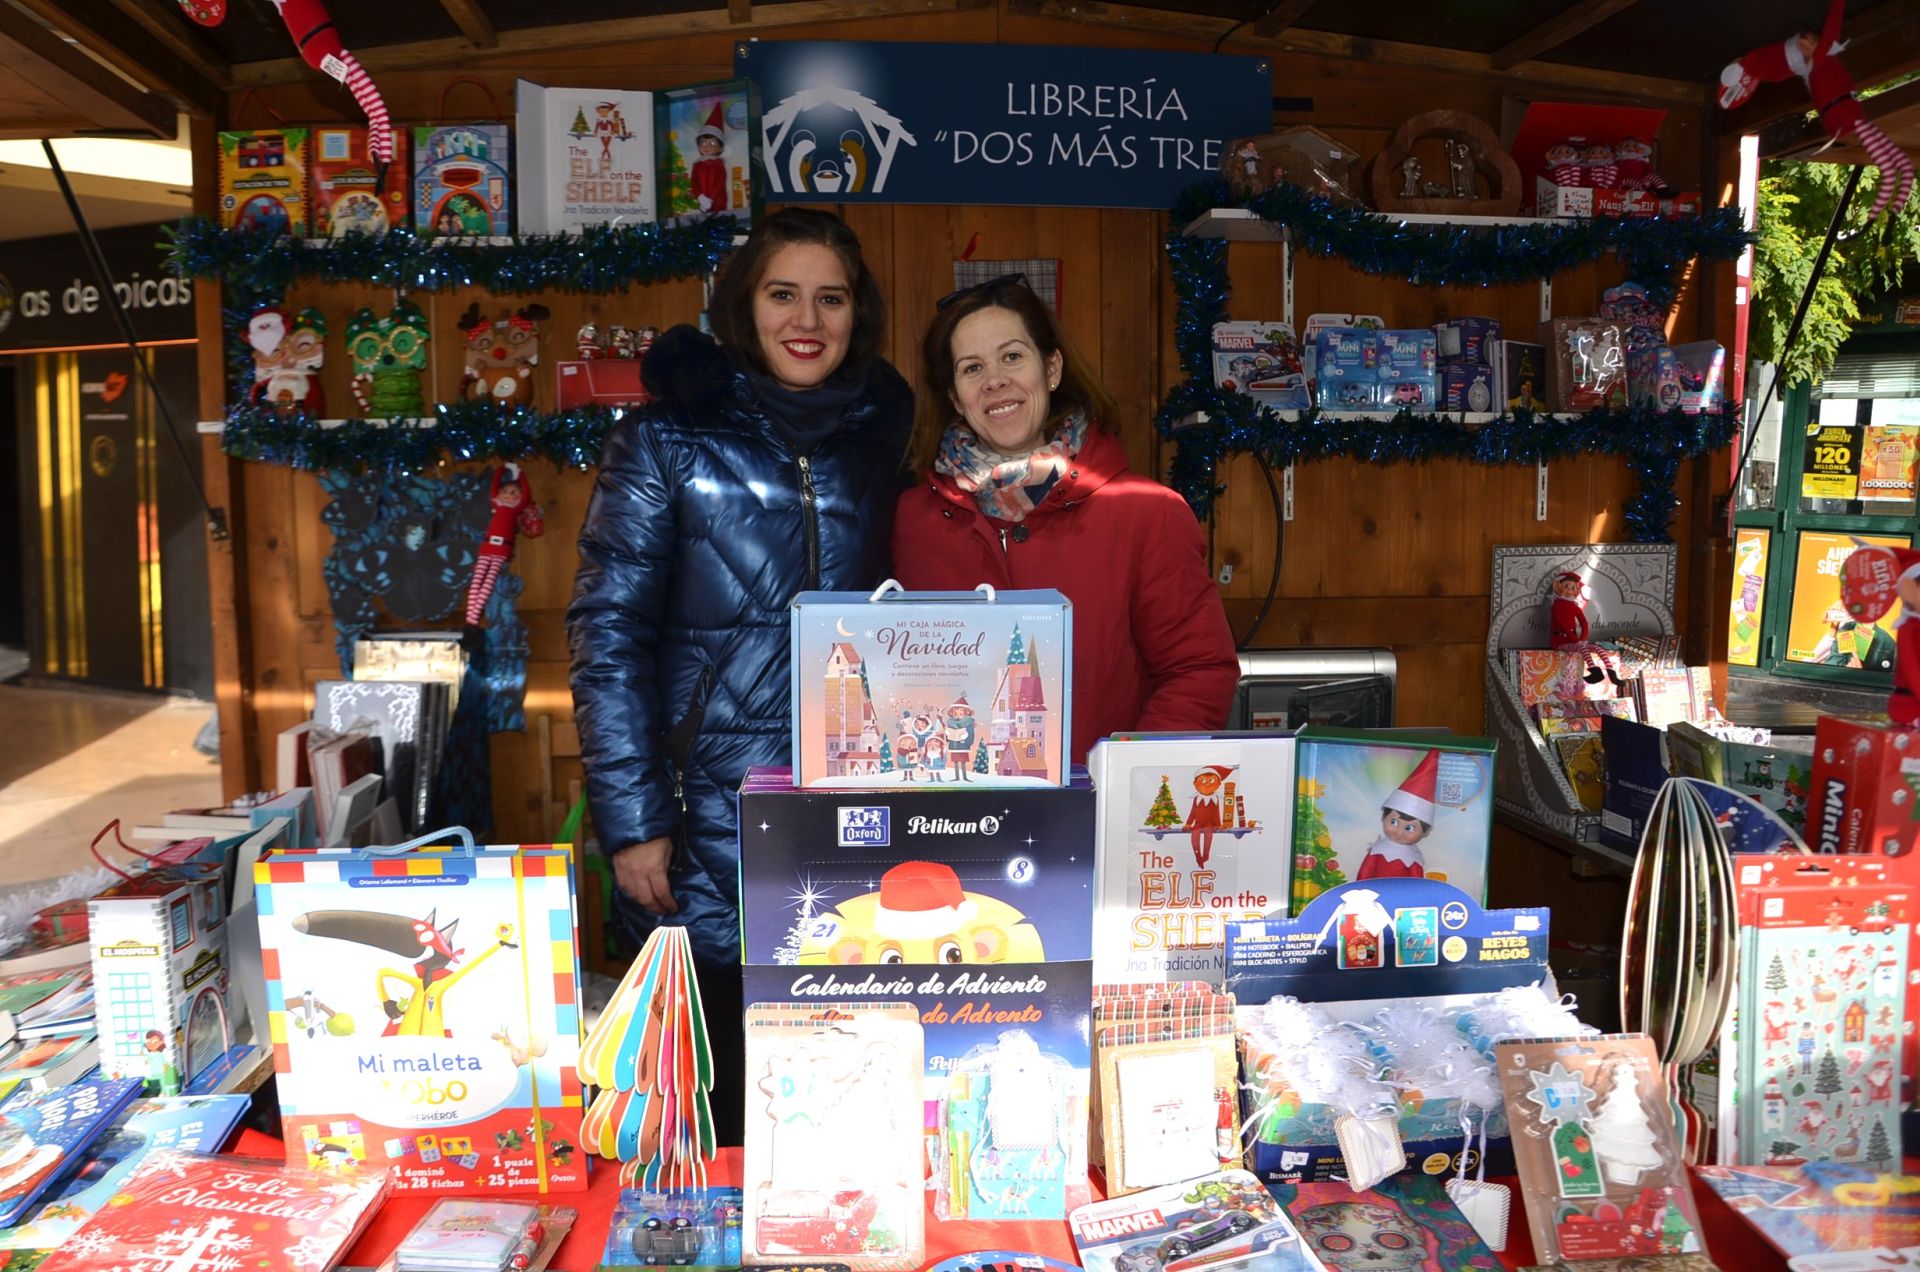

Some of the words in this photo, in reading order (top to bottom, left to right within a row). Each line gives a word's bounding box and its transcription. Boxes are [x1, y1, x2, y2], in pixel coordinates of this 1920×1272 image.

[1007, 78, 1188, 121] LIBRERÍA
[568, 146, 588, 156] The
[1047, 125, 1138, 170] MÁS
[570, 158, 611, 179] ELF
[609, 172, 623, 180] on
[625, 170, 642, 180] the
[566, 181, 642, 203] SHELF
[20, 290, 50, 318] as
[62, 278, 99, 314] de
[1219, 337, 1254, 349] MARVEL
[1814, 447, 1851, 464] 120
[910, 621, 930, 629] CAJA
[933, 619, 965, 628] MÁGICA
[877, 627, 986, 661] Navidad
[847, 827, 881, 841] Oxford
[907, 816, 977, 835] Pelikan
[1139, 851, 1174, 868] The
[1012, 860, 1030, 880] 8
[1140, 870, 1216, 910] ELF
[1211, 896, 1233, 909] on
[1238, 890, 1267, 907] the
[1445, 910, 1464, 921] 24x
[812, 923, 837, 937] 21
[1482, 935, 1528, 948] REYES
[115, 947, 157, 956] HOSPITAL
[1479, 947, 1530, 961] MAGOS
[1152, 955, 1210, 971] Tradición
[791, 972, 914, 996] Calendario
[917, 972, 945, 995] de
[947, 972, 1047, 996] Adviento
[921, 1002, 949, 1024] do
[950, 1002, 1043, 1024] Advento
[358, 1053, 385, 1073] Mi
[393, 1052, 482, 1072] maleta
[493, 1156, 501, 1168] 1
[405, 1168, 445, 1177] dominó
[508, 1168, 520, 1176] de
[211, 1172, 303, 1198] Feliz
[411, 1177, 428, 1189] 28
[431, 1178, 465, 1188] fichas
[488, 1174, 506, 1187] 25
[508, 1177, 540, 1188] piezas
[159, 1187, 332, 1220] Navidad
[1080, 1210, 1165, 1242] MARVEL
